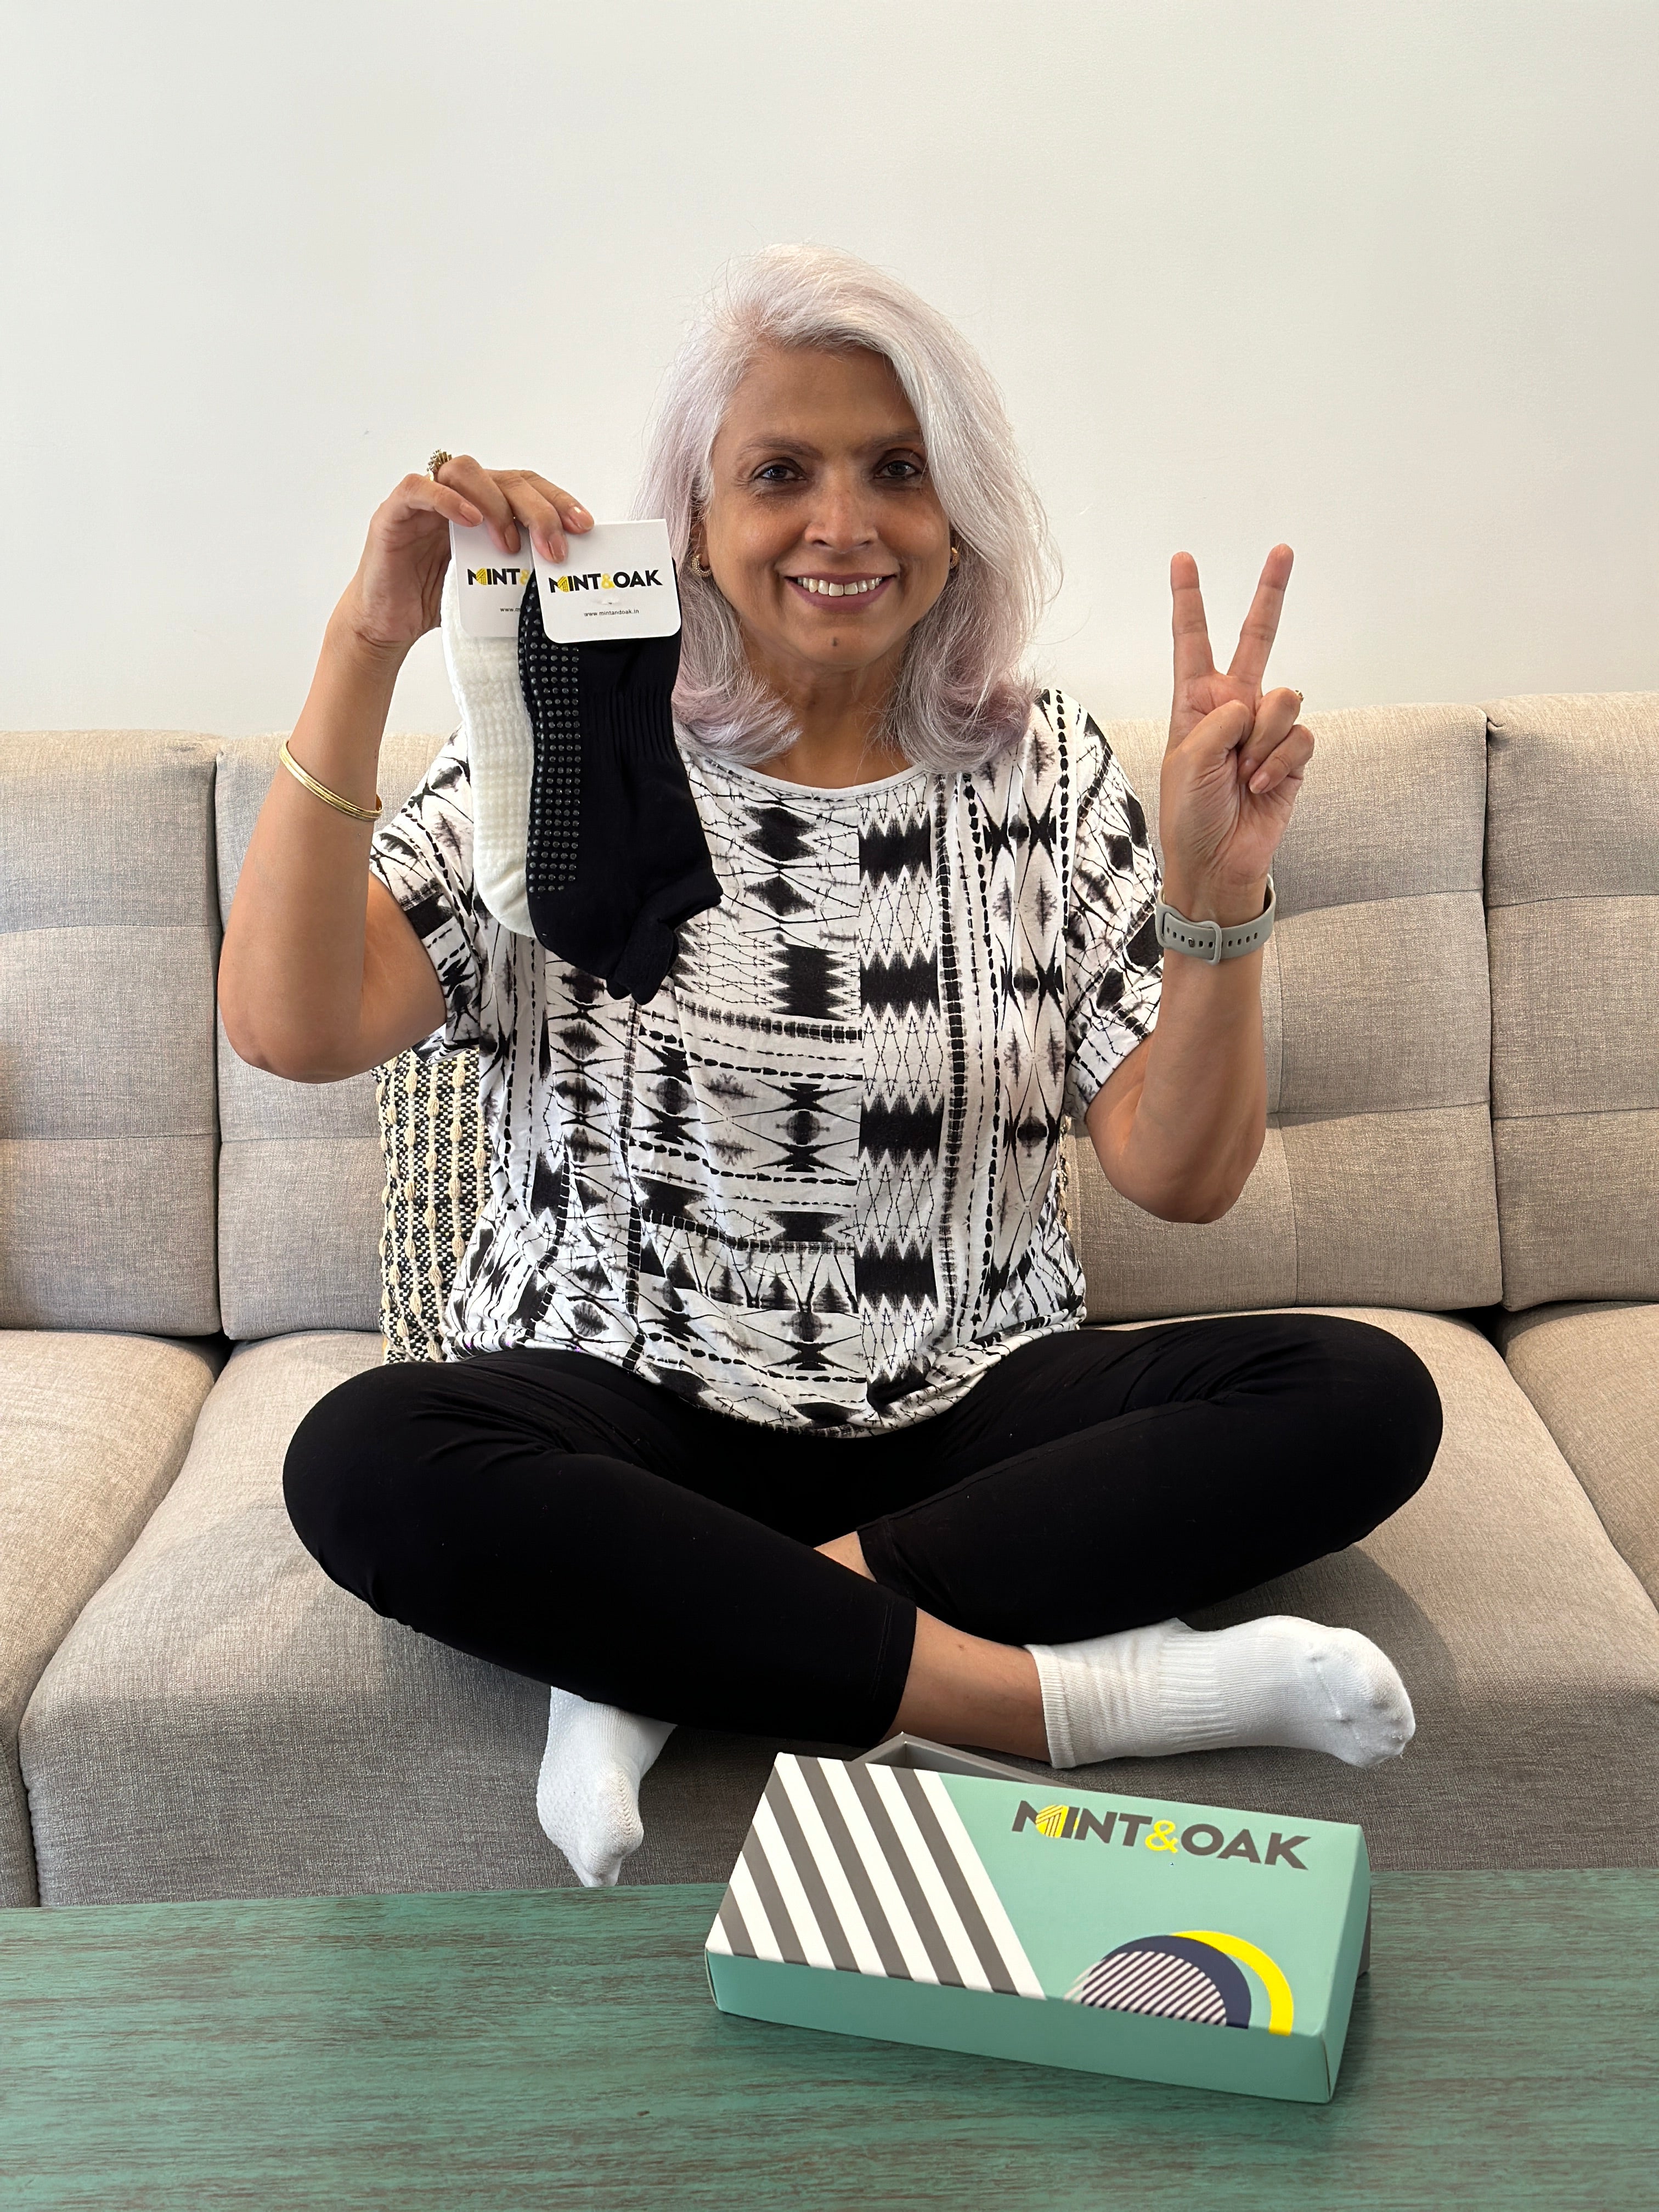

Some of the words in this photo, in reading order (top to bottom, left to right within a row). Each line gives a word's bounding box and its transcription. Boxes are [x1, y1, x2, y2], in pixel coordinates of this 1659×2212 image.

[549, 569, 663, 593] MINT&OAK
[584, 608, 639, 617] wwwmintandoak.in
[1012, 1800, 1312, 1870] MINT&OAK
